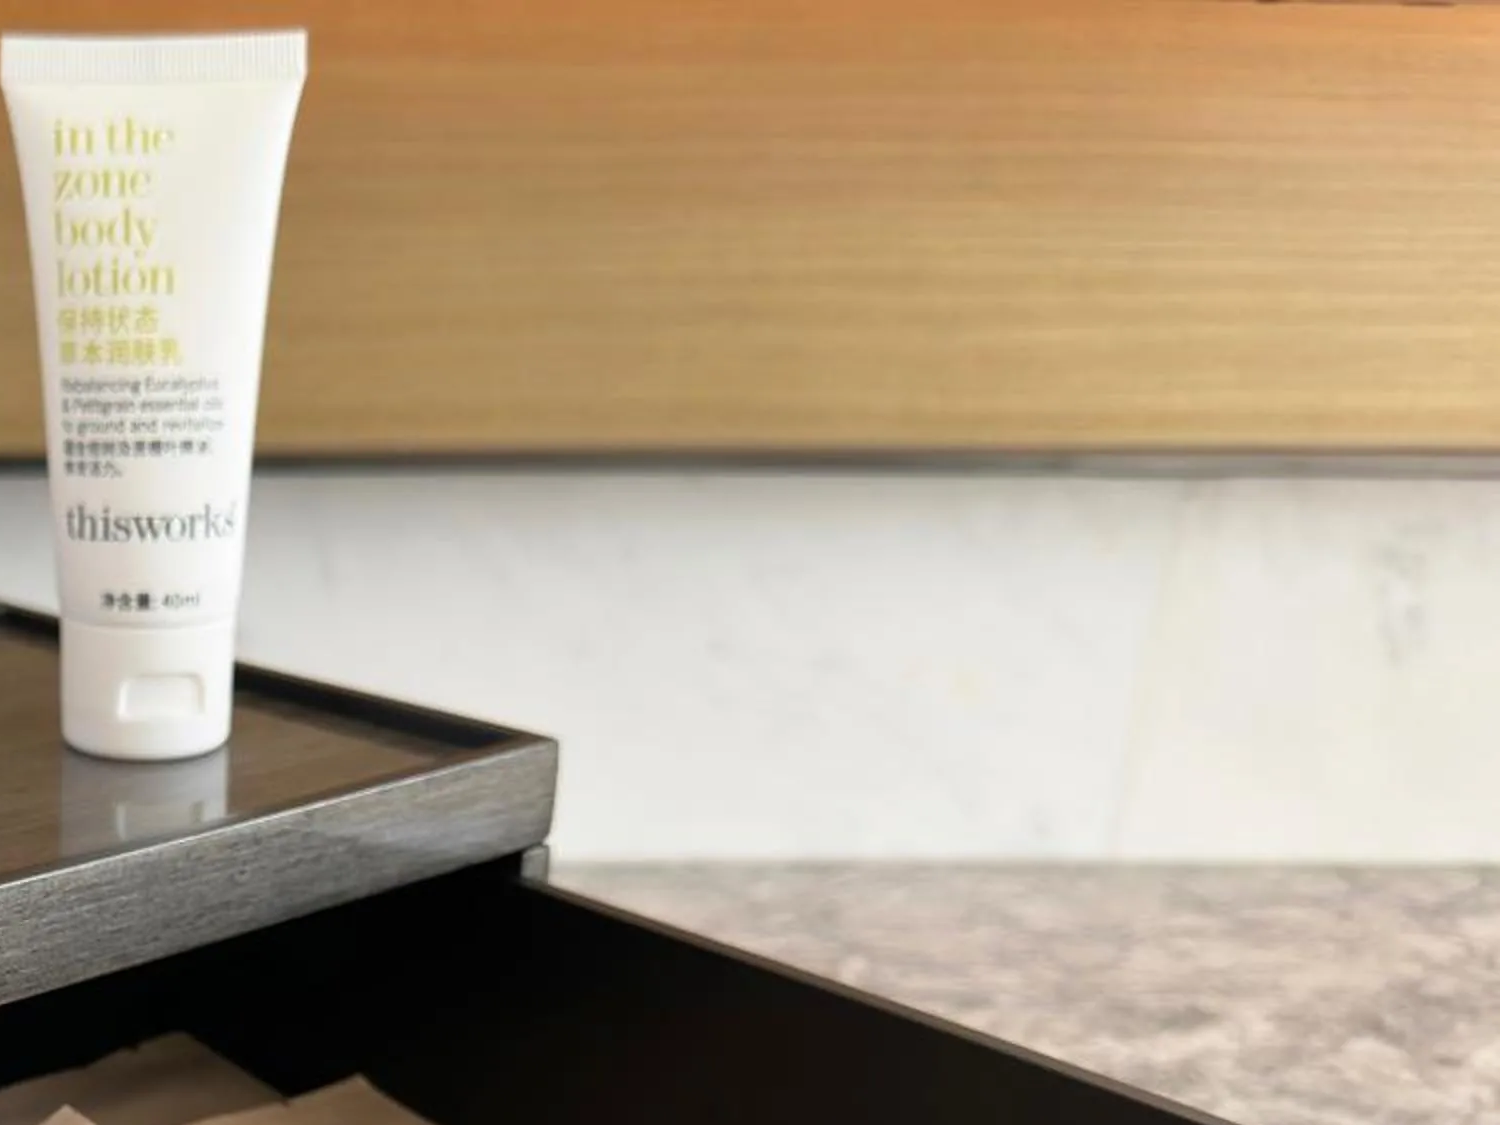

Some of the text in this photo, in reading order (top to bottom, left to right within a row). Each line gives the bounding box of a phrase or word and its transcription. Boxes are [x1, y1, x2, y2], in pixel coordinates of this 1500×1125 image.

[53, 115, 175, 157] in the
[53, 168, 153, 202] zone
[53, 207, 159, 257] body
[56, 254, 176, 298] lotion
[130, 417, 158, 433] and
[65, 503, 236, 544] thisworks
